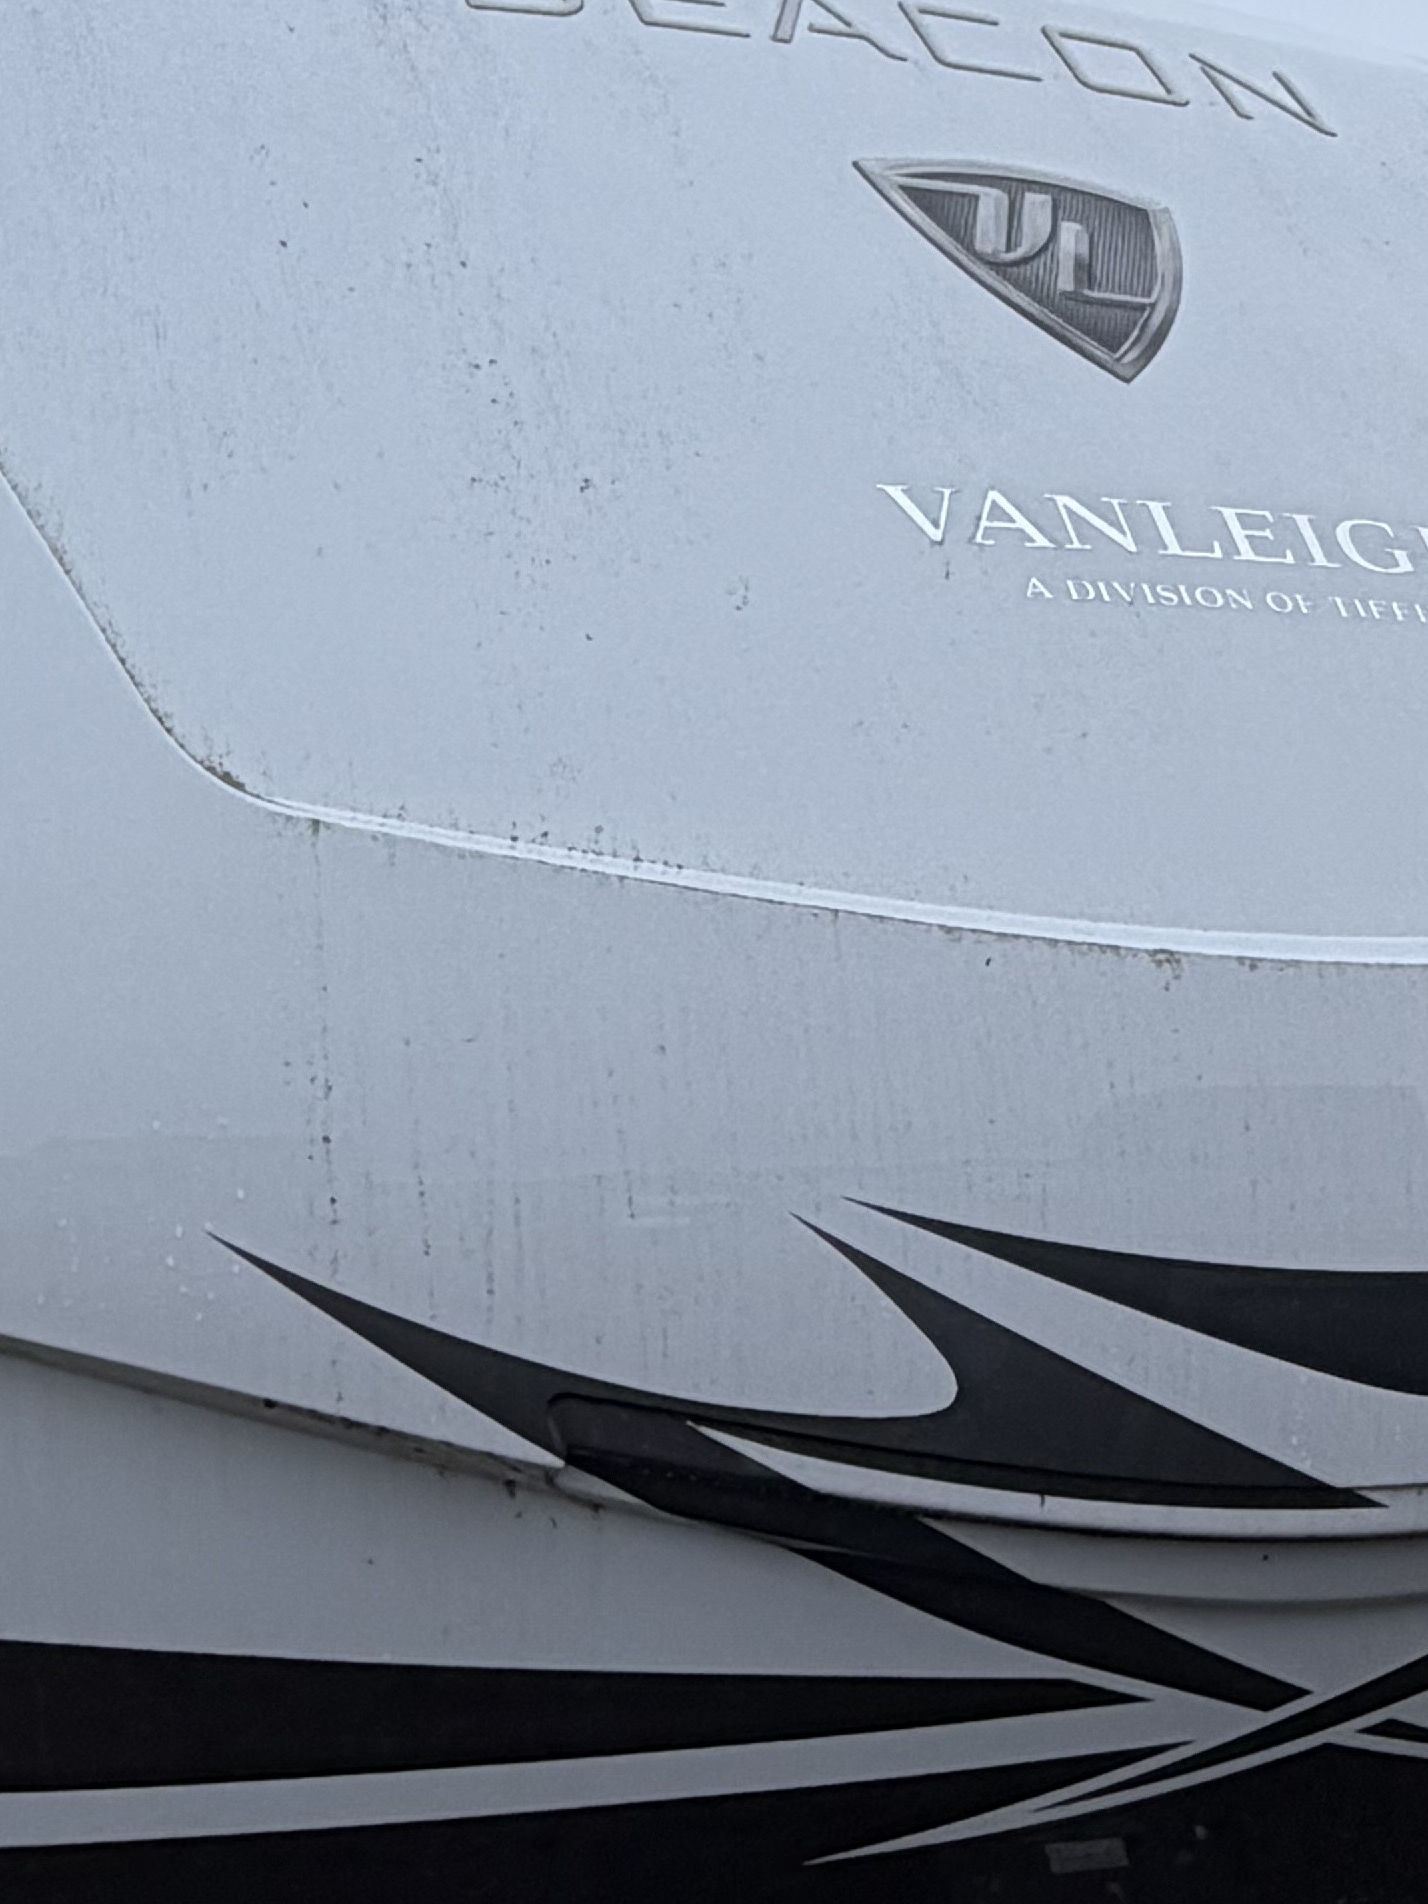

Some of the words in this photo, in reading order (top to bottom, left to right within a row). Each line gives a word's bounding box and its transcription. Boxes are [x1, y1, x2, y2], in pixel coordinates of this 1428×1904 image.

[1025, 575, 1053, 602] A
[1066, 577, 1254, 611] DIVISION
[1265, 591, 1313, 614] OF
